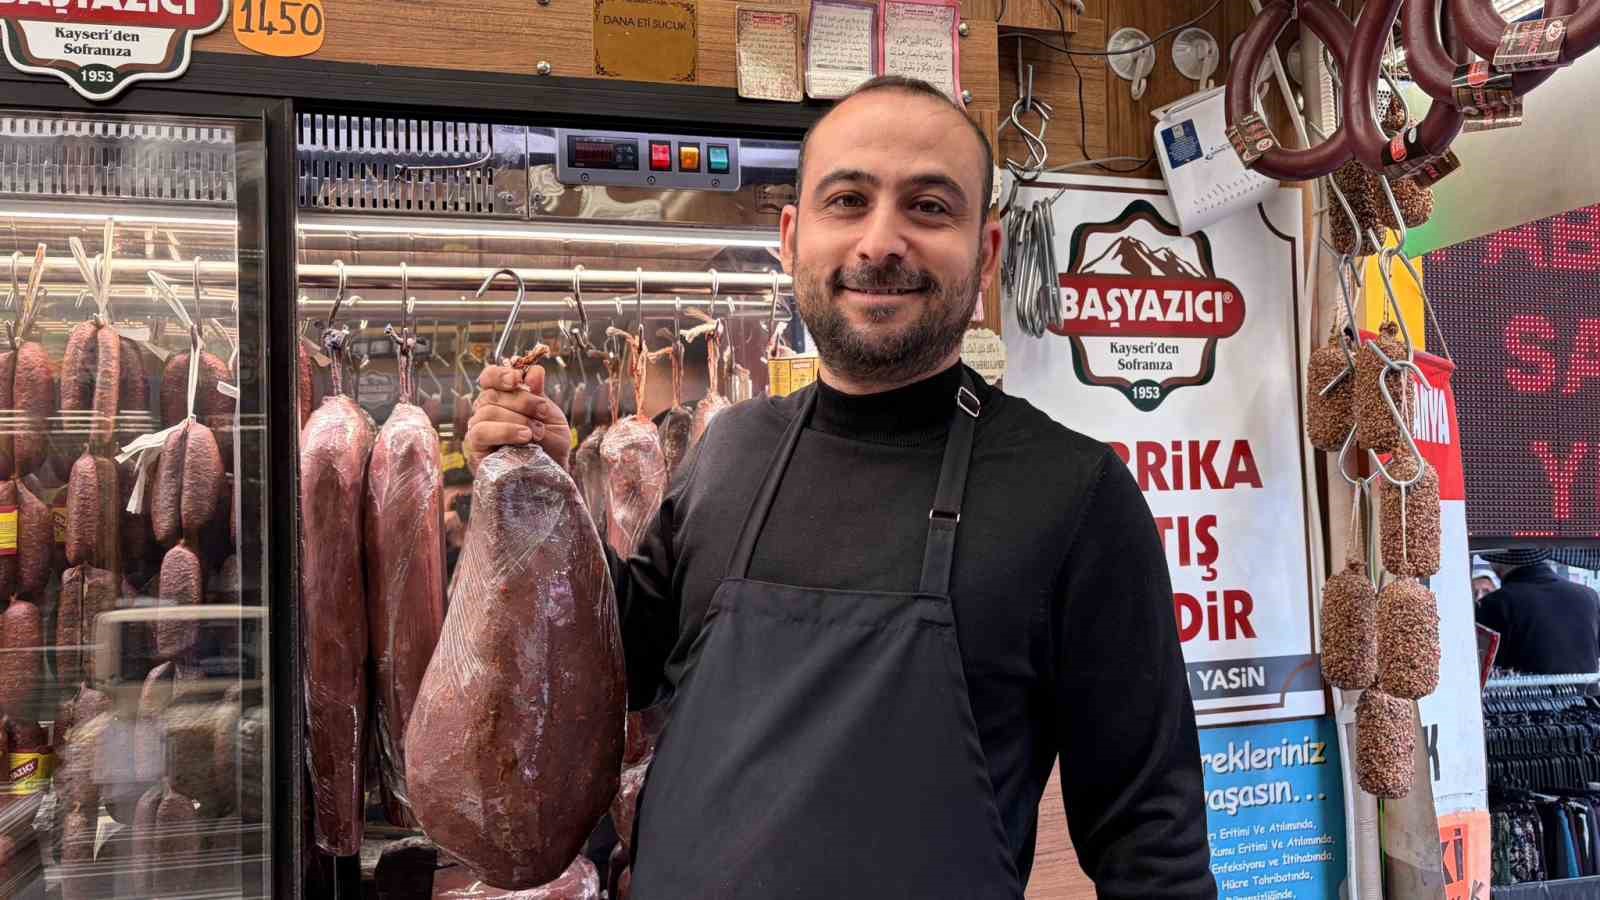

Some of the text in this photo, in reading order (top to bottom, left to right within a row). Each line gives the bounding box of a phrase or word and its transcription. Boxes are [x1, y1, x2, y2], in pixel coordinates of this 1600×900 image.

[238, 0, 322, 36] 1450
[603, 15, 635, 26] DANA
[652, 19, 687, 31] SUCUK
[55, 27, 140, 42] Kayseri'den
[63, 43, 132, 57] Sofranıza
[81, 69, 115, 83] 1953
[1110, 341, 1180, 356] Kayseri'den
[1117, 358, 1173, 371] Sofranıza
[1131, 386, 1160, 399] 1953
[1196, 665, 1265, 692] YASİN
[1253, 824, 1265, 835] Ve
[1271, 838, 1283, 849] Ve
